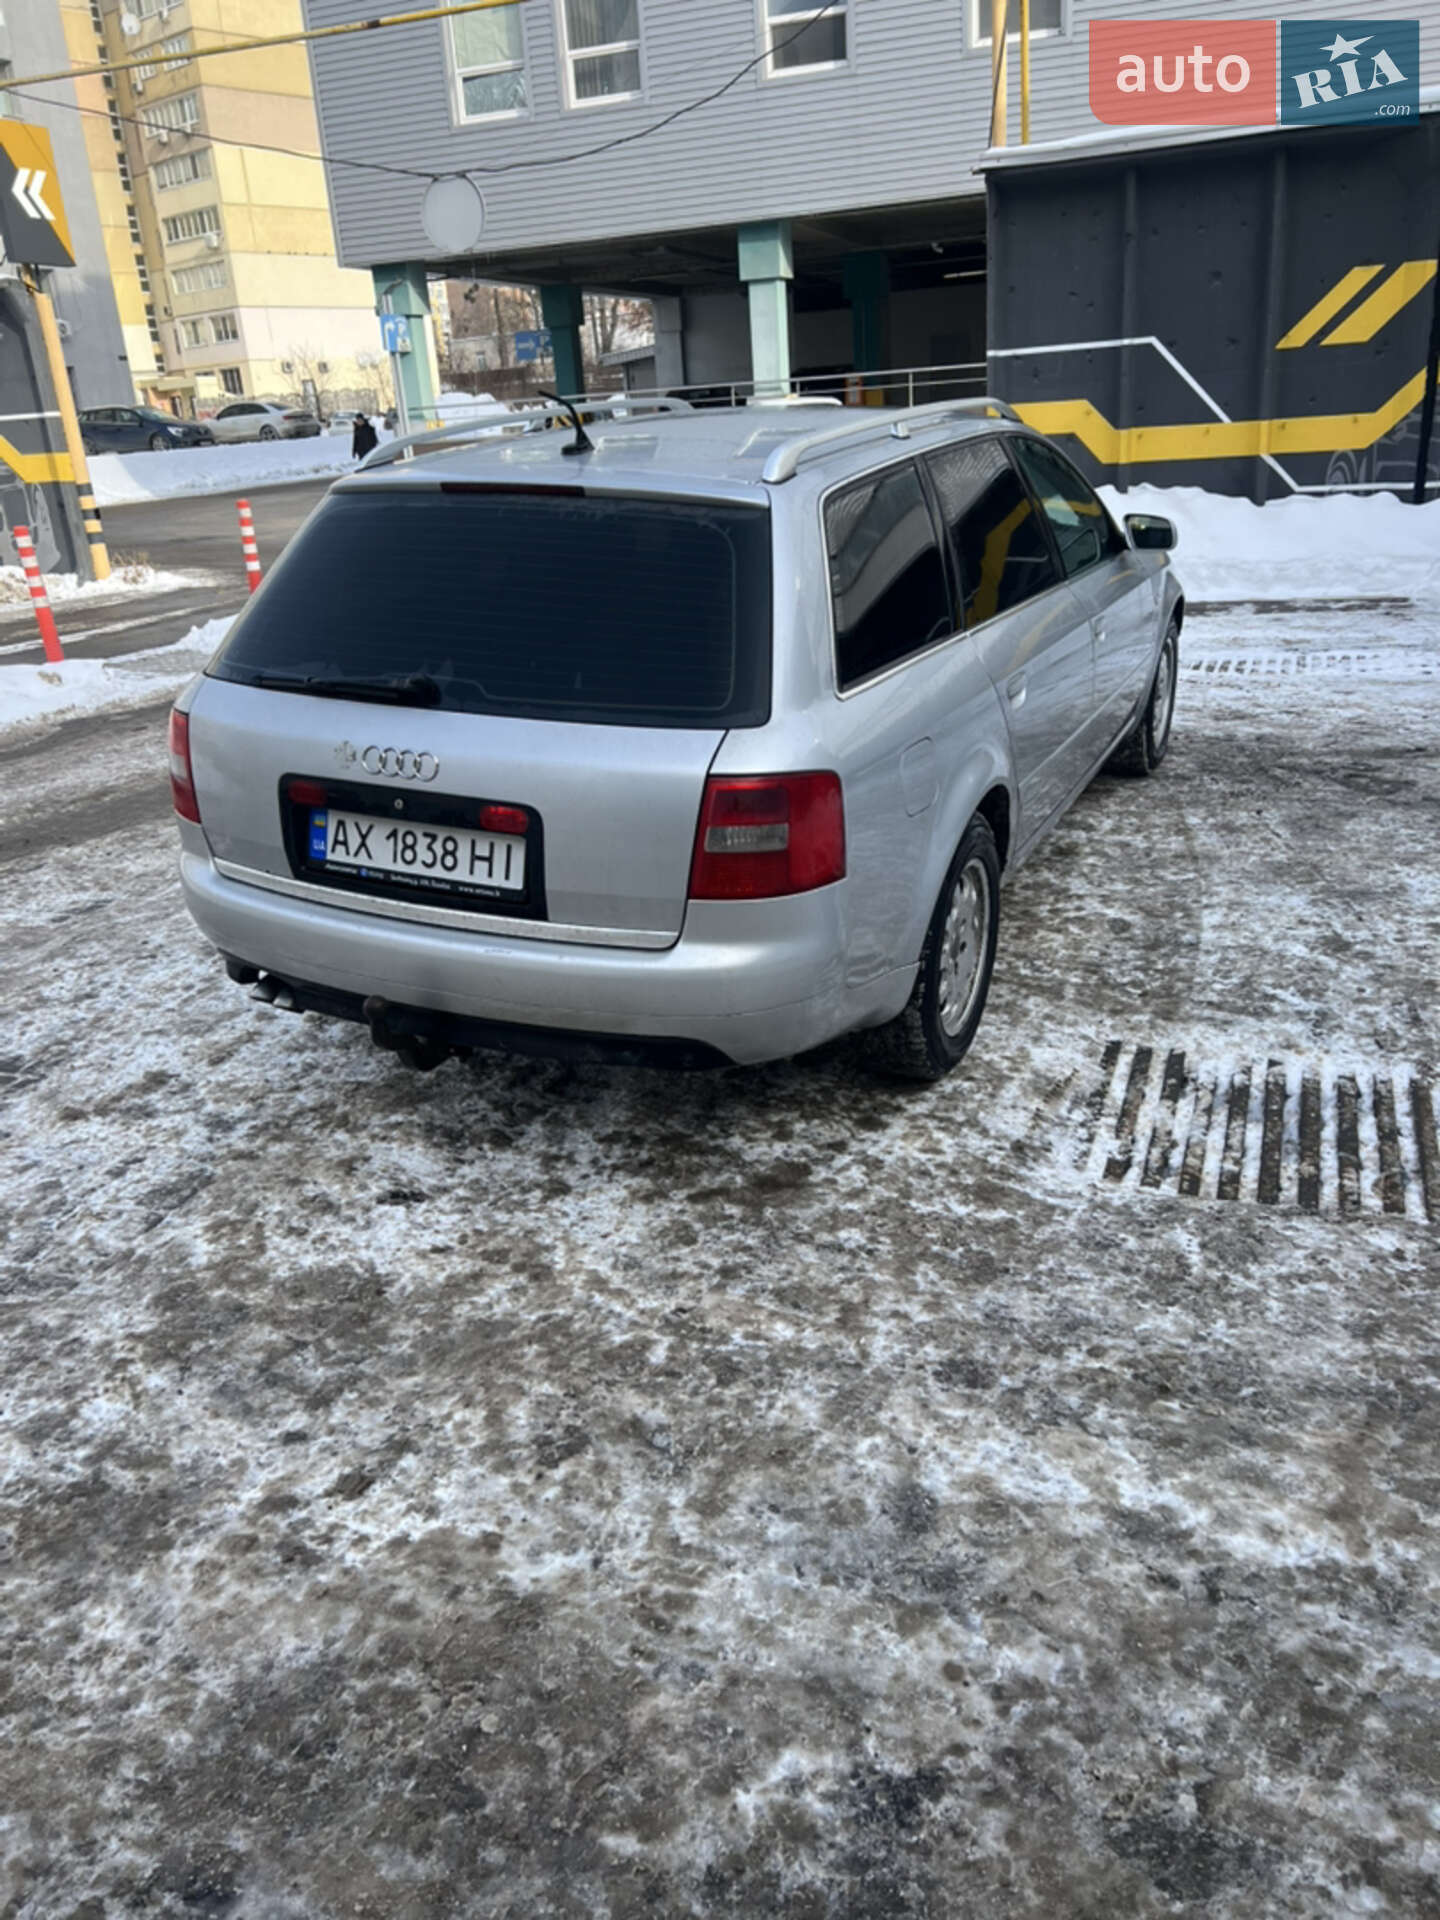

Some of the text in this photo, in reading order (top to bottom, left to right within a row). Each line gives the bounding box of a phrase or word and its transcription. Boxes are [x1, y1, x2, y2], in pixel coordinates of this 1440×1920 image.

[312, 840, 326, 850] UA
[330, 819, 375, 861] AX
[385, 827, 459, 872] 1838
[469, 838, 512, 881] HI
